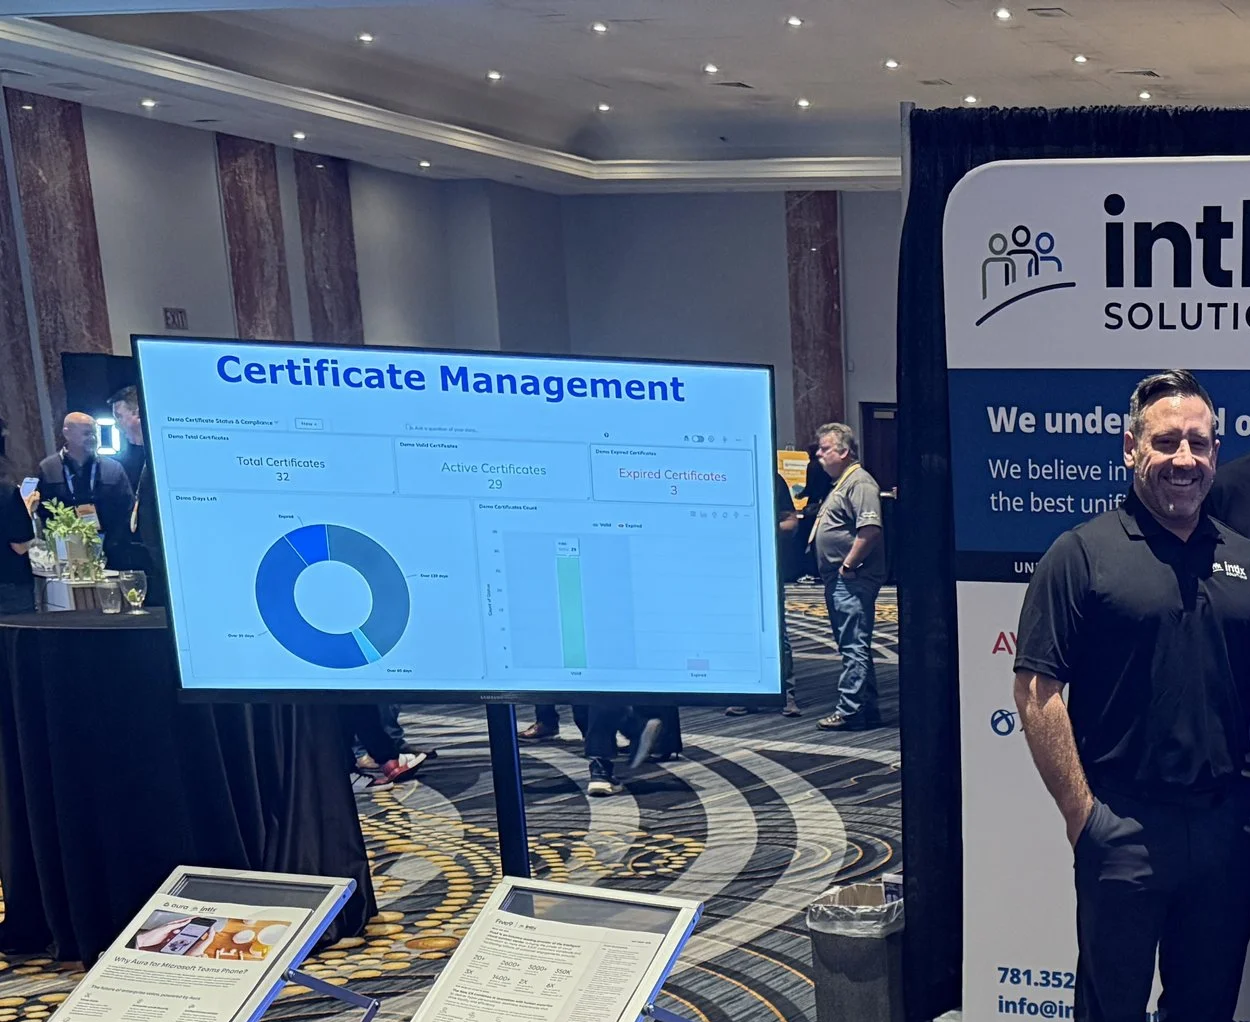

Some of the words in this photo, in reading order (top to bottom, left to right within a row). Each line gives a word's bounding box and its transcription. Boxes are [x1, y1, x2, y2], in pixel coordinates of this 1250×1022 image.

[217, 355, 425, 391] Certificate
[440, 365, 685, 403] Management
[987, 406, 1036, 434] We
[236, 456, 263, 466] Total
[266, 457, 326, 468] Certificates
[441, 462, 478, 474] Active
[481, 463, 547, 476] Certificates
[988, 458, 1022, 480] We
[1028, 458, 1102, 481] believe
[1109, 460, 1127, 482] in
[276, 472, 290, 482] 32
[619, 467, 661, 481] Expired
[664, 469, 728, 482] Certificates
[488, 479, 503, 490] 29
[670, 486, 678, 496] 3
[990, 490, 1024, 512] the
[1030, 491, 1075, 514] best
[114, 956, 130, 964] Why
[130, 958, 148, 966] Aura
[150, 960, 161, 968] for
[162, 962, 196, 971] Microsoft
[198, 966, 220, 974] Teams
[998, 966, 1075, 990] 781.352
